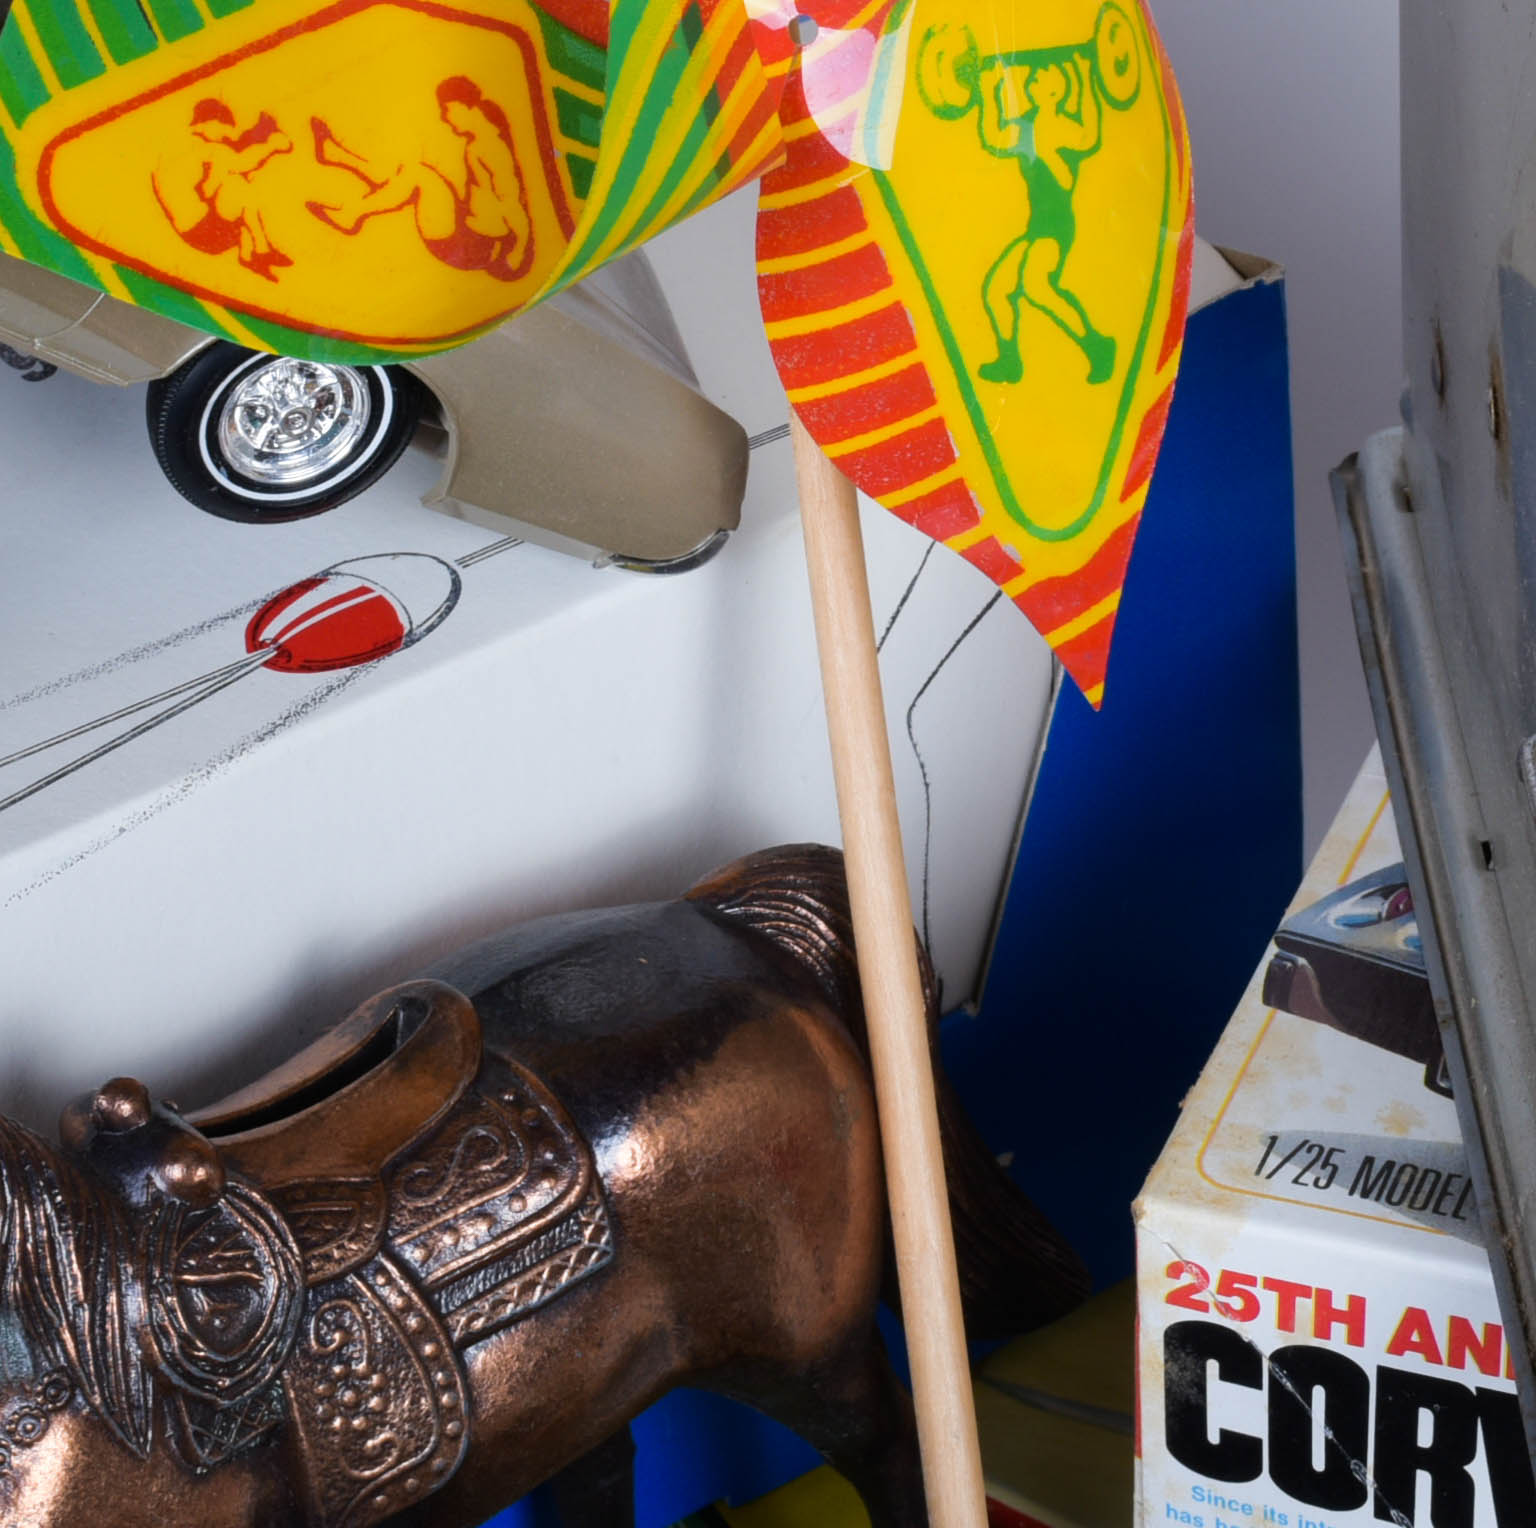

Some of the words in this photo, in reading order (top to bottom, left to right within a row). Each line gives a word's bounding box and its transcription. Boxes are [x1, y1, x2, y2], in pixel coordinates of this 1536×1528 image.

[1253, 1133, 1346, 1190] 1/25
[1347, 1155, 1473, 1222] MODEL
[1164, 1259, 1367, 1348] 25TH
[1386, 1305, 1517, 1380] AN
[1165, 1503, 1205, 1528] has
[1191, 1484, 1254, 1516] Since
[1263, 1504, 1289, 1526] its
